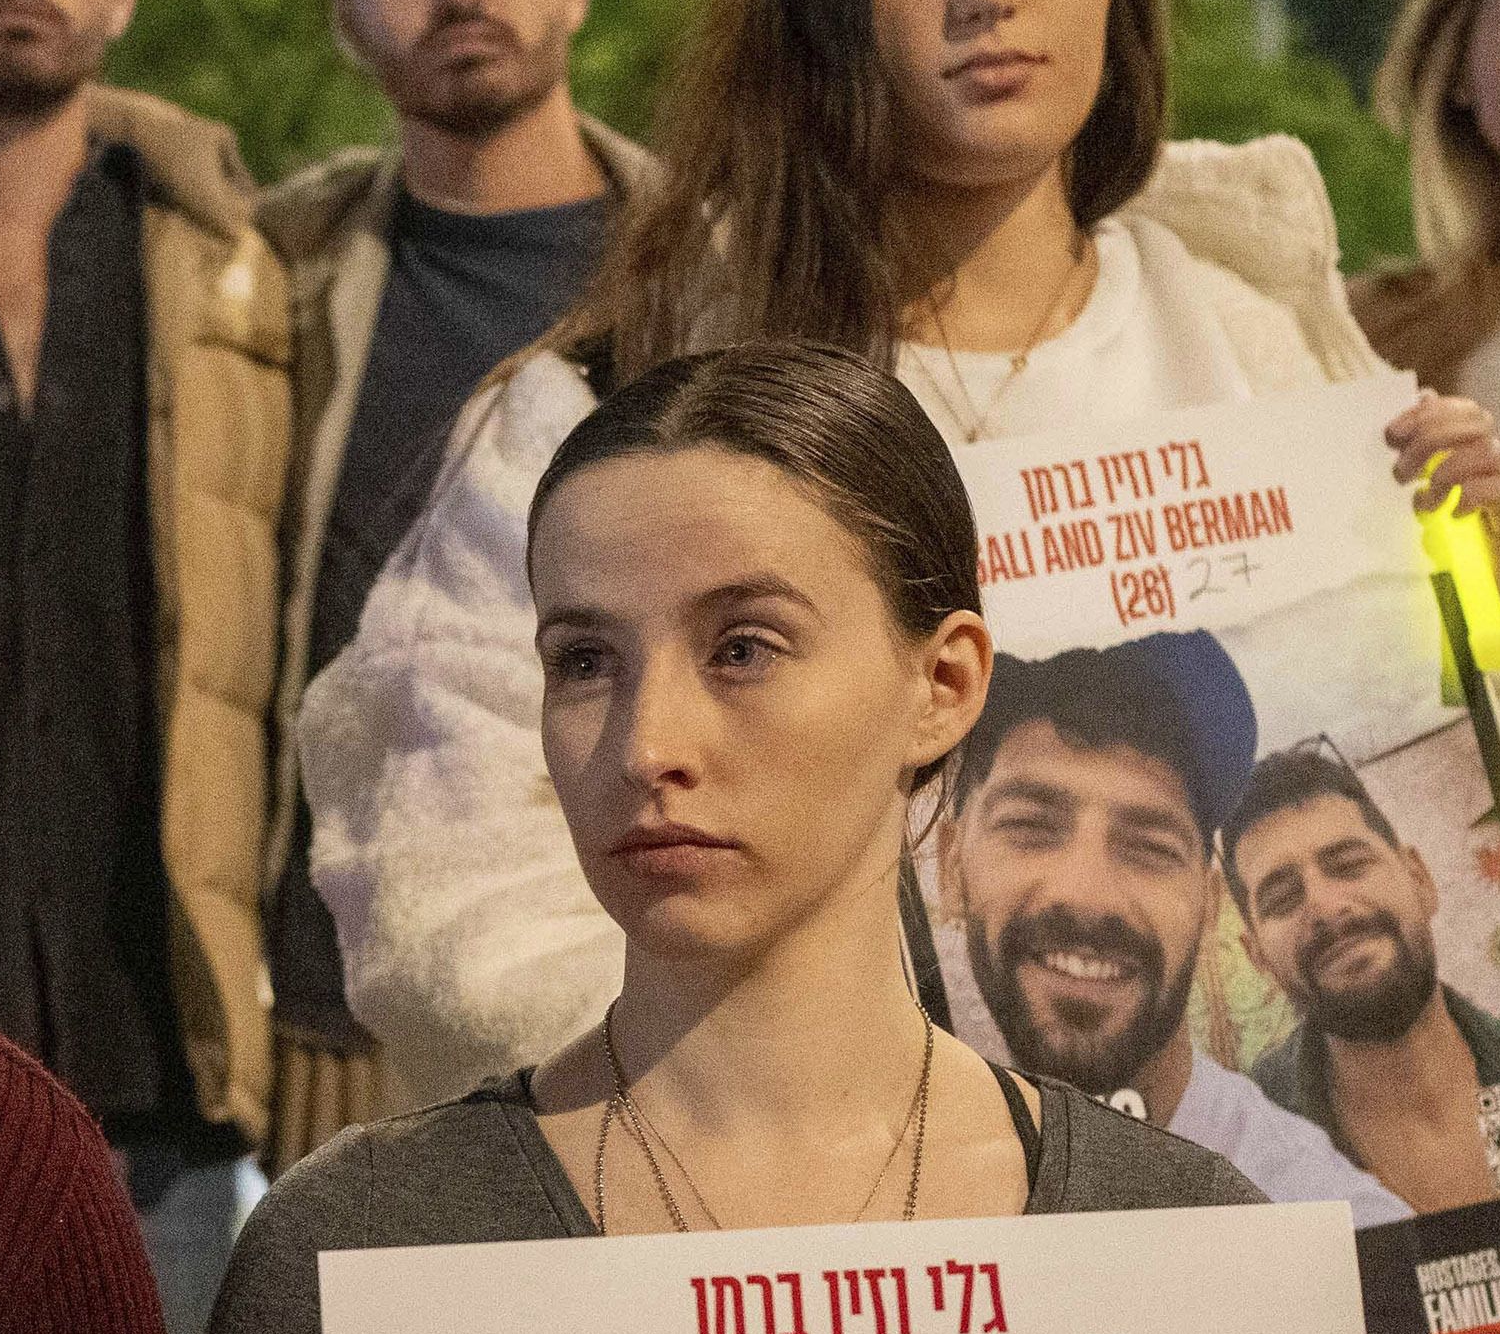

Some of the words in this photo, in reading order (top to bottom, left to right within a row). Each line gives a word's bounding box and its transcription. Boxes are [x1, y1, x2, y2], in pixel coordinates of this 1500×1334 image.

[1020, 460, 1095, 522] ברמן
[1098, 450, 1155, 503] וזיו
[1157, 441, 1210, 490] גלי
[1042, 520, 1104, 574] AND
[1107, 509, 1156, 562] ZIV
[1162, 487, 1292, 552] BERMAN
[1111, 565, 1175, 626] (26)
[1187, 552, 1260, 601] 27
[927, 1260, 1007, 1334] גלי
